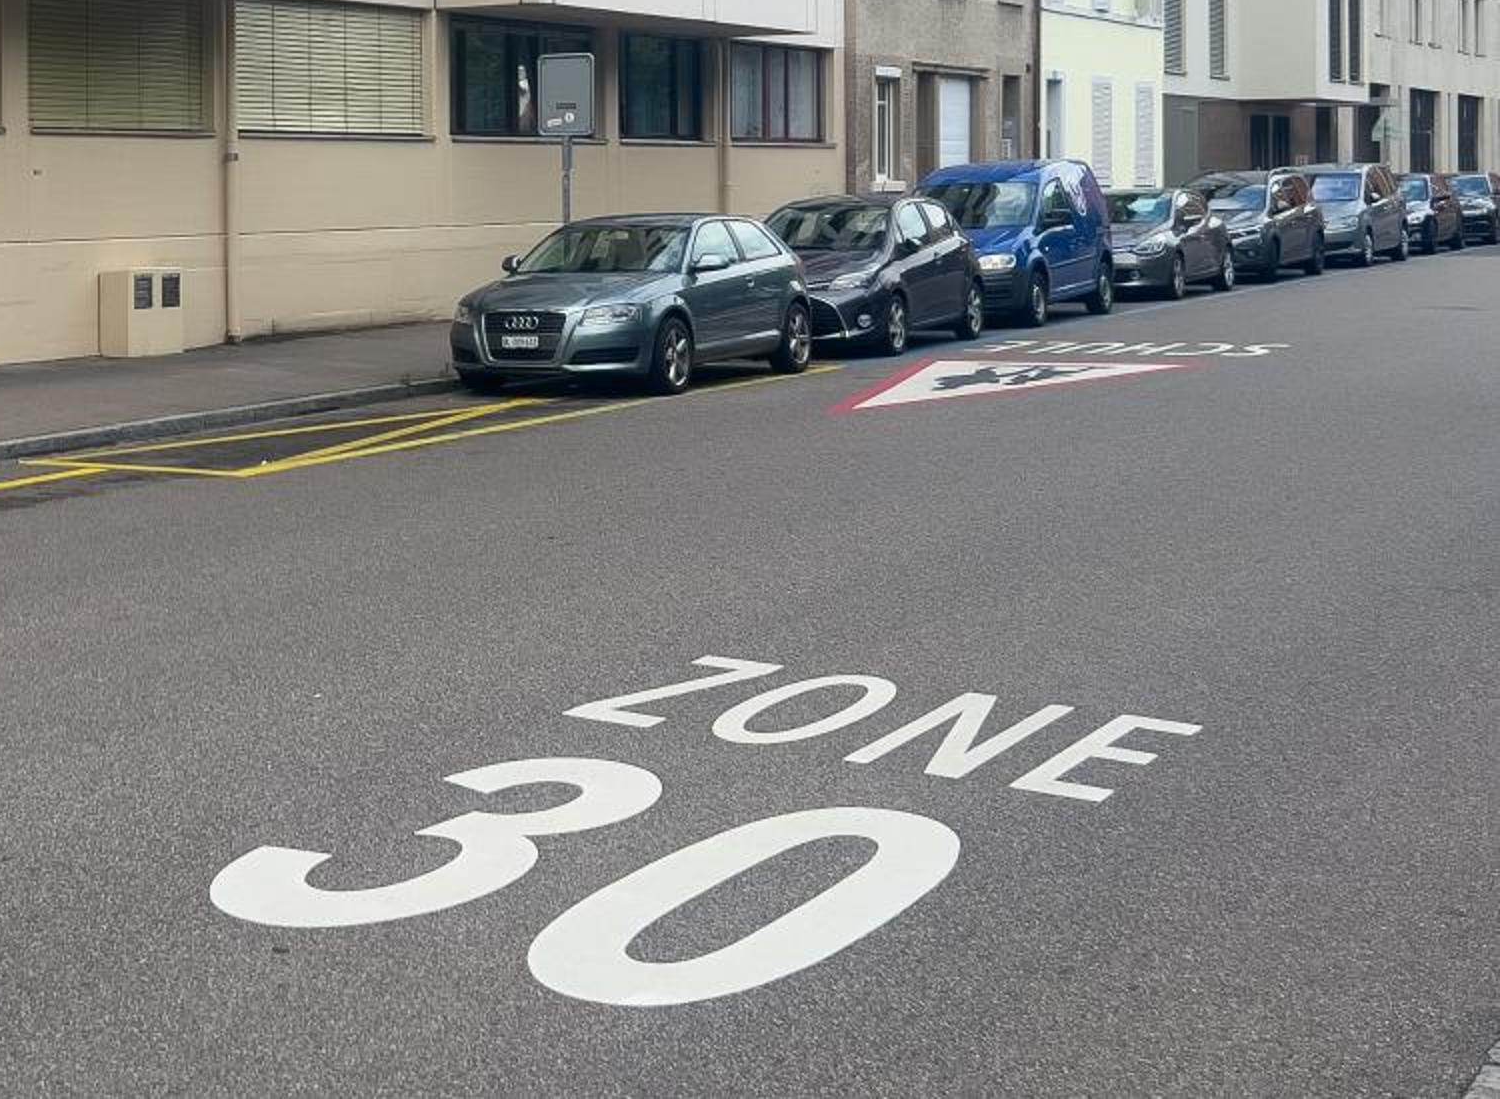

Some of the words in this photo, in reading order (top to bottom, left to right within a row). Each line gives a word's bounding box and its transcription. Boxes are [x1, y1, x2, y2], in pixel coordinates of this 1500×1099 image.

[964, 340, 1291, 356] SCHULE
[562, 654, 1203, 803] ZONE
[209, 756, 961, 1008] 30
